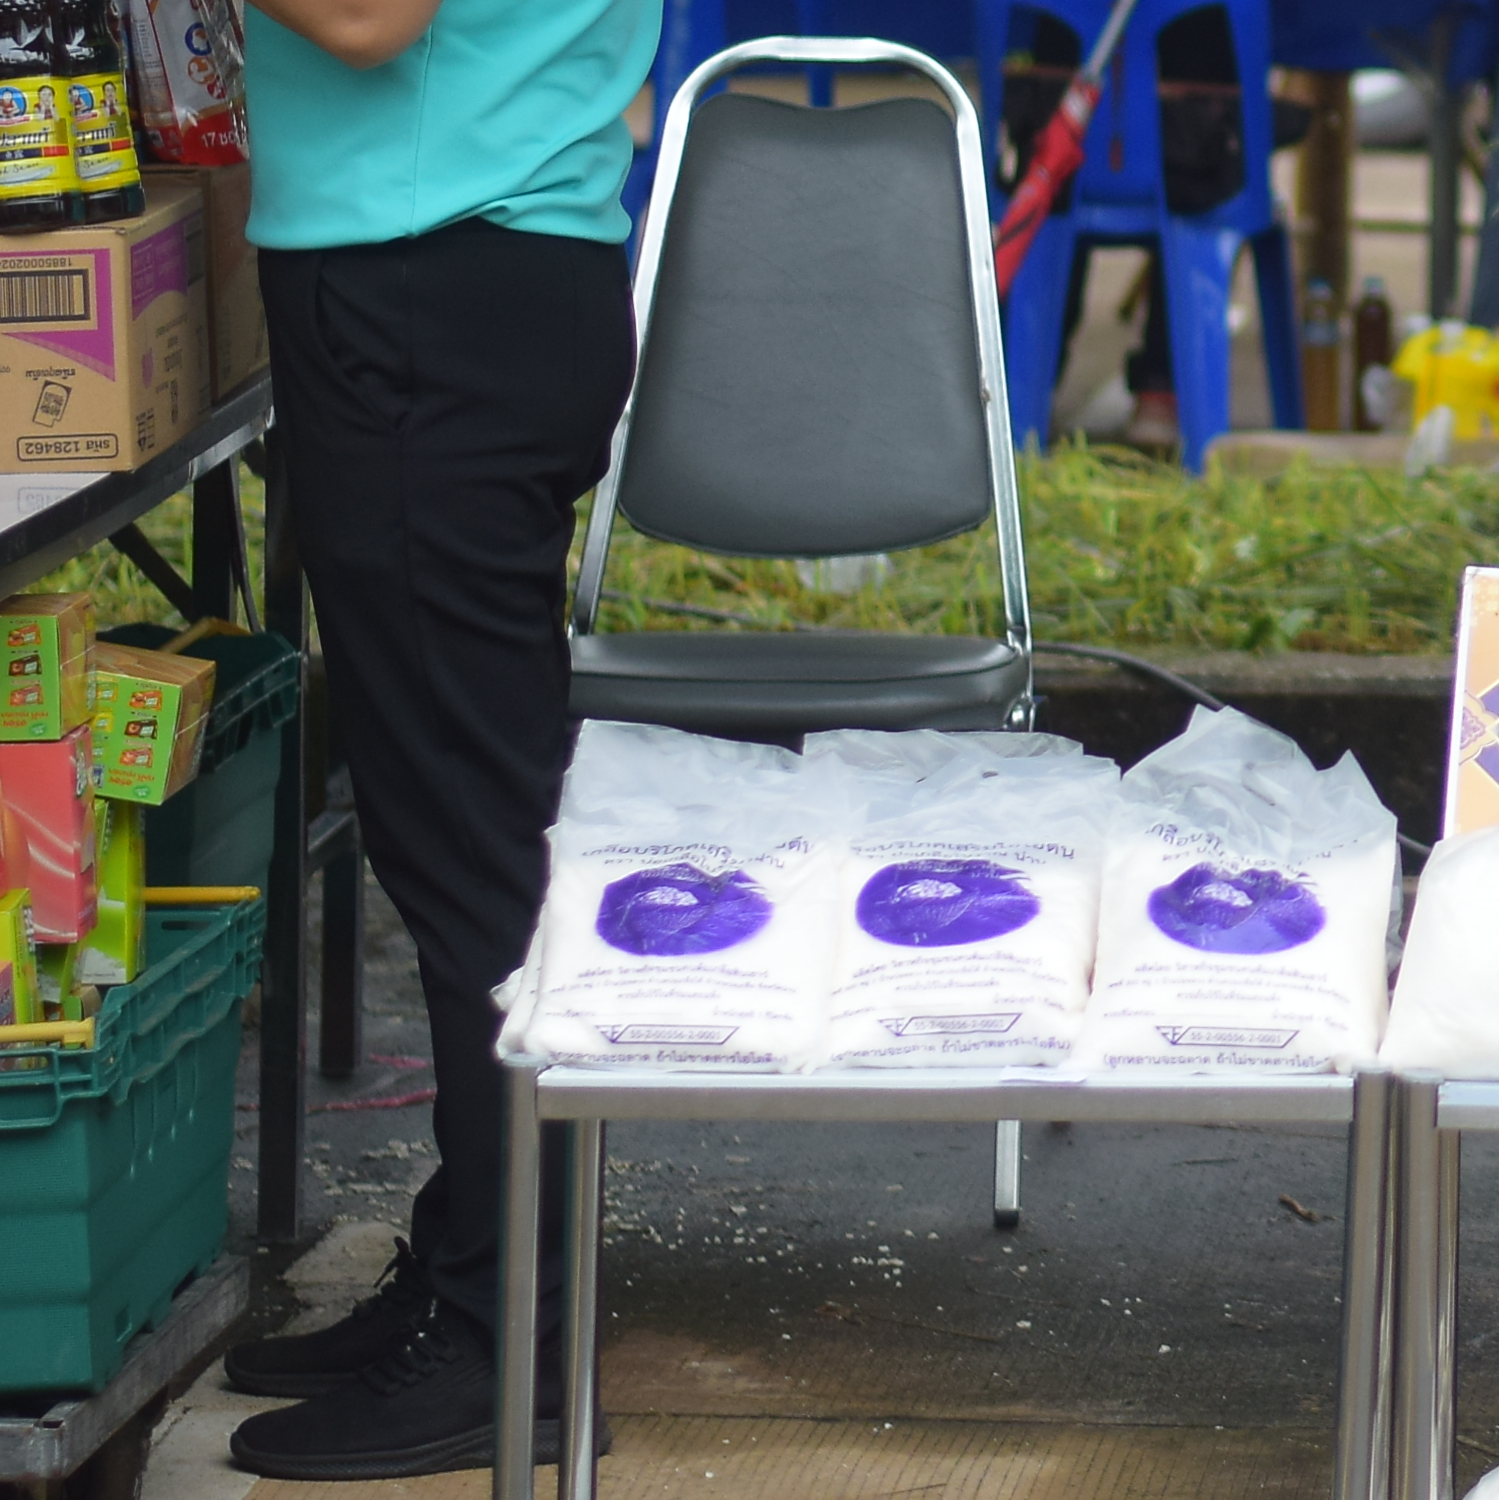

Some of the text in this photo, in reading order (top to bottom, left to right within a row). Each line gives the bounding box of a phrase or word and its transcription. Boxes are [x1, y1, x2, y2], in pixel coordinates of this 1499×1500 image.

[0, 256, 73, 269] 1885000202
[24, 439, 110, 455] รหัส 128462
